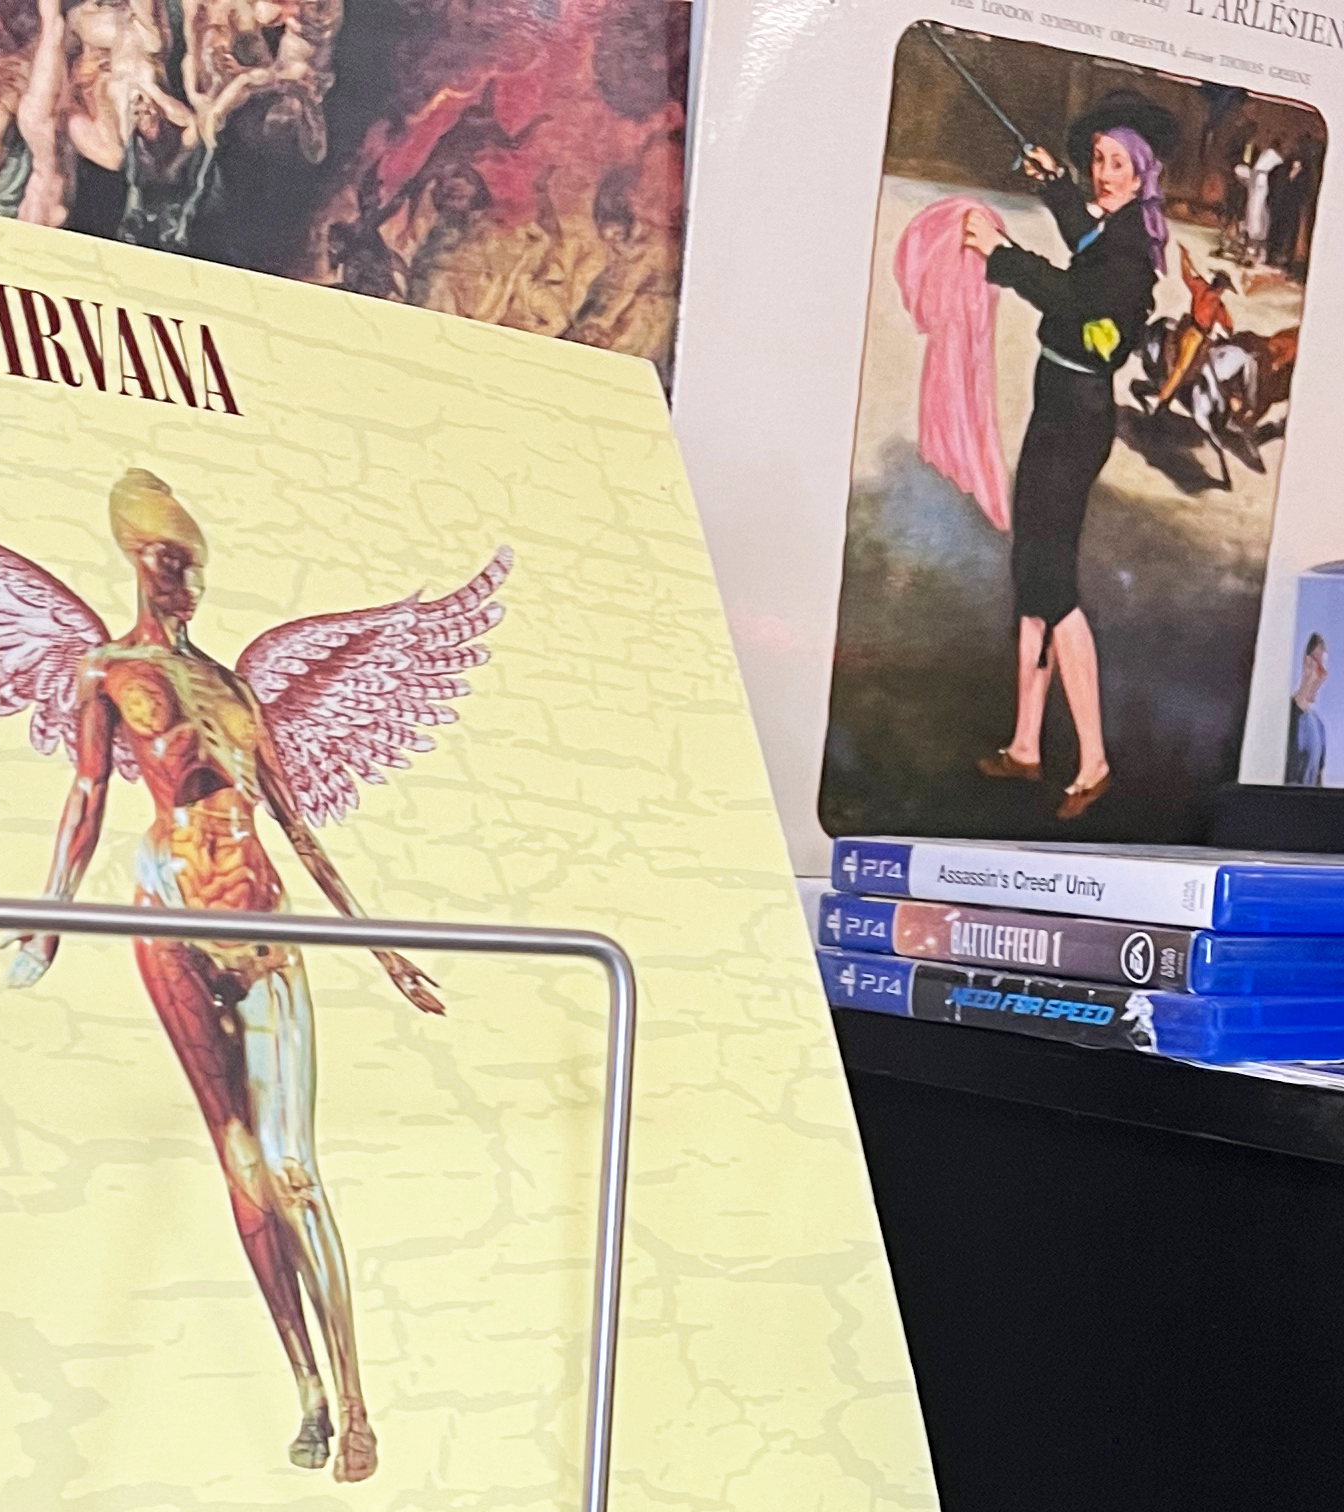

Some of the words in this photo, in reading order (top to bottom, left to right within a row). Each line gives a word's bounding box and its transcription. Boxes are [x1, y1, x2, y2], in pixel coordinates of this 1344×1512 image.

[862, 858, 903, 879] PS4
[937, 864, 1011, 890] Assassin's
[1066, 874, 1106, 902] Unity
[845, 916, 886, 938] PS4
[950, 921, 1049, 967] BATTLEFIELD
[1052, 931, 1064, 968] 1
[860, 973, 902, 996] PS4
[950, 987, 1002, 1011] NEED
[999, 993, 1045, 1017] FOR
[1041, 999, 1115, 1026] SPEED
